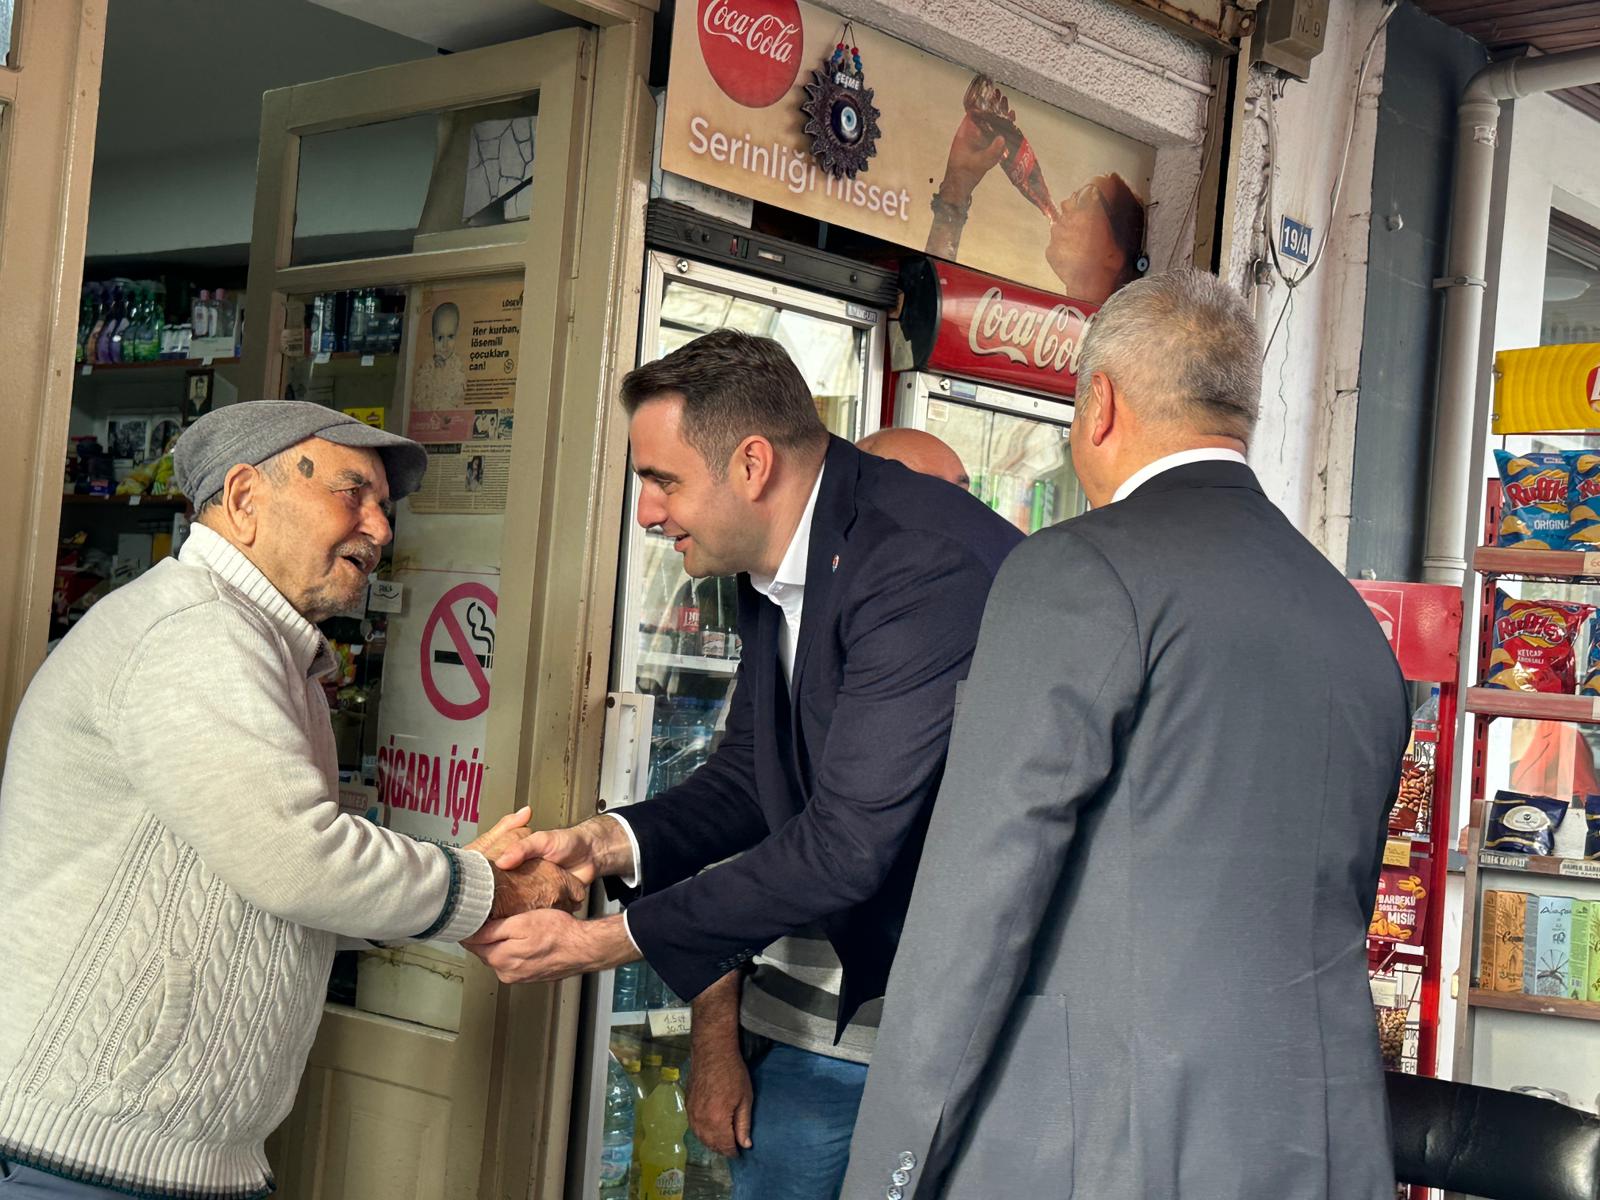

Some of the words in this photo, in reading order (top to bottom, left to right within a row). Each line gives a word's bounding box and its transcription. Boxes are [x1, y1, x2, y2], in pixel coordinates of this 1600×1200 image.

[703, 0, 800, 63] Coca-Cola
[688, 116, 816, 193] Serinliği
[1284, 225, 1309, 256] 19/A
[471, 336, 503, 348] lösemili
[472, 327, 488, 336] Her
[489, 325, 520, 335] kurban,
[968, 286, 1097, 375] Coca-Col
[469, 349, 510, 362] çocuklara
[469, 362, 486, 371] can!
[1505, 476, 1569, 509] Ruffle
[1534, 519, 1570, 531] ORIGINA
[1495, 612, 1567, 645] Ruffles
[376, 735, 441, 816] SİGARA
[445, 744, 484, 837] İÇİL
